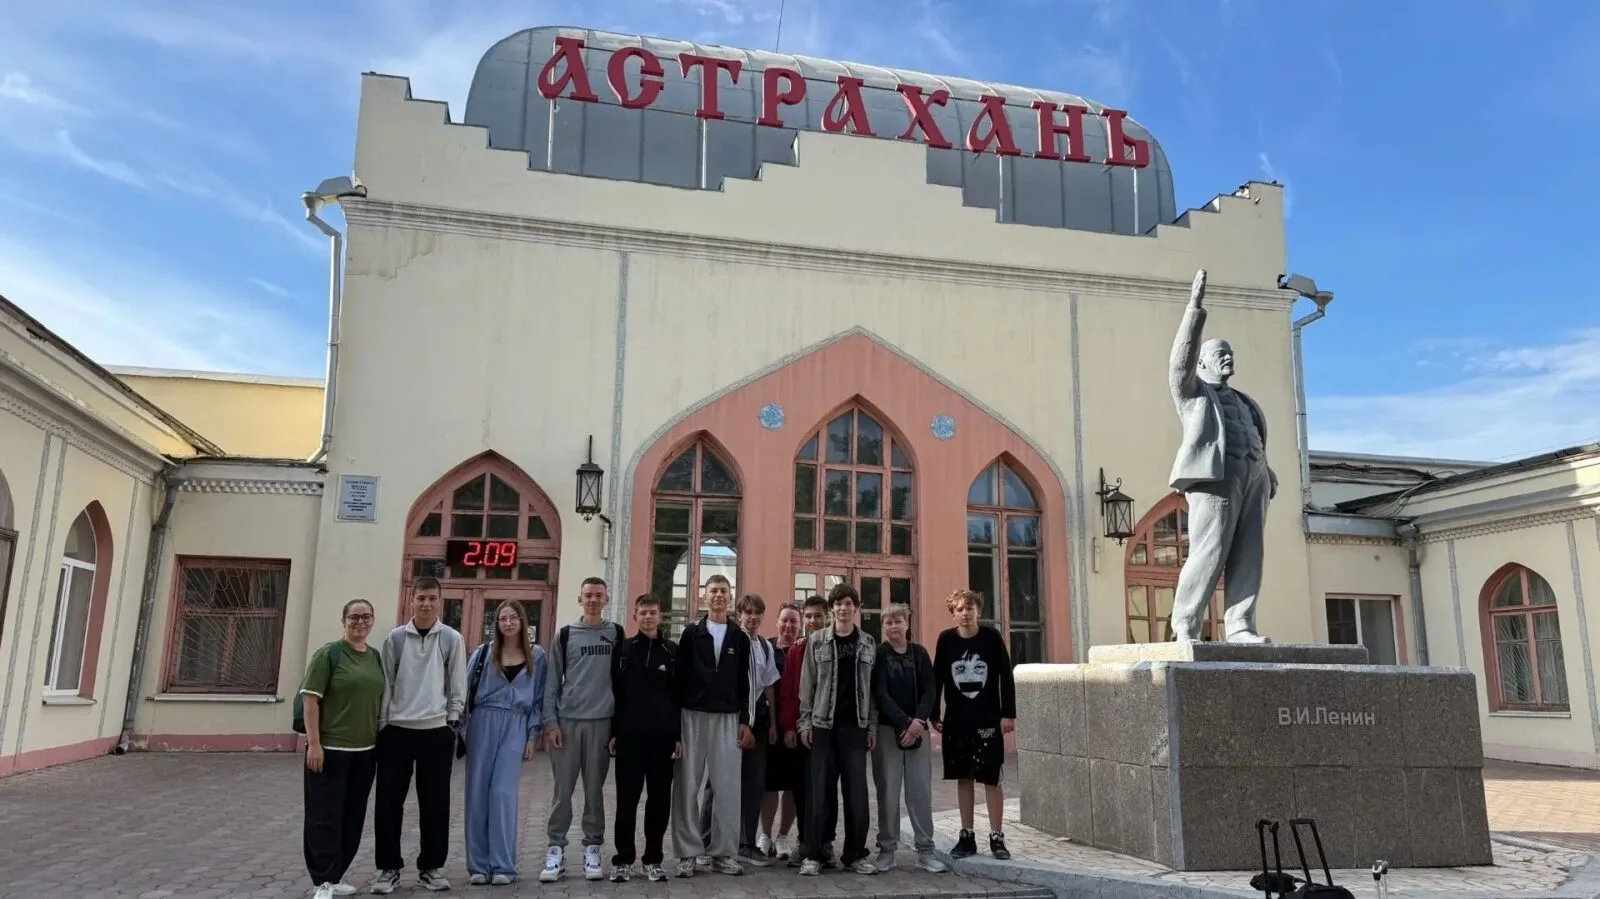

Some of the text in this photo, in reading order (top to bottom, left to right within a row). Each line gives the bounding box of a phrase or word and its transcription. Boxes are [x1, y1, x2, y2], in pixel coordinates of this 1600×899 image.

[537, 36, 1150, 168] АСТРАХАНЬ
[580, 644, 611, 656] PUMA
[1277, 706, 1376, 726] В.И.Ленин
